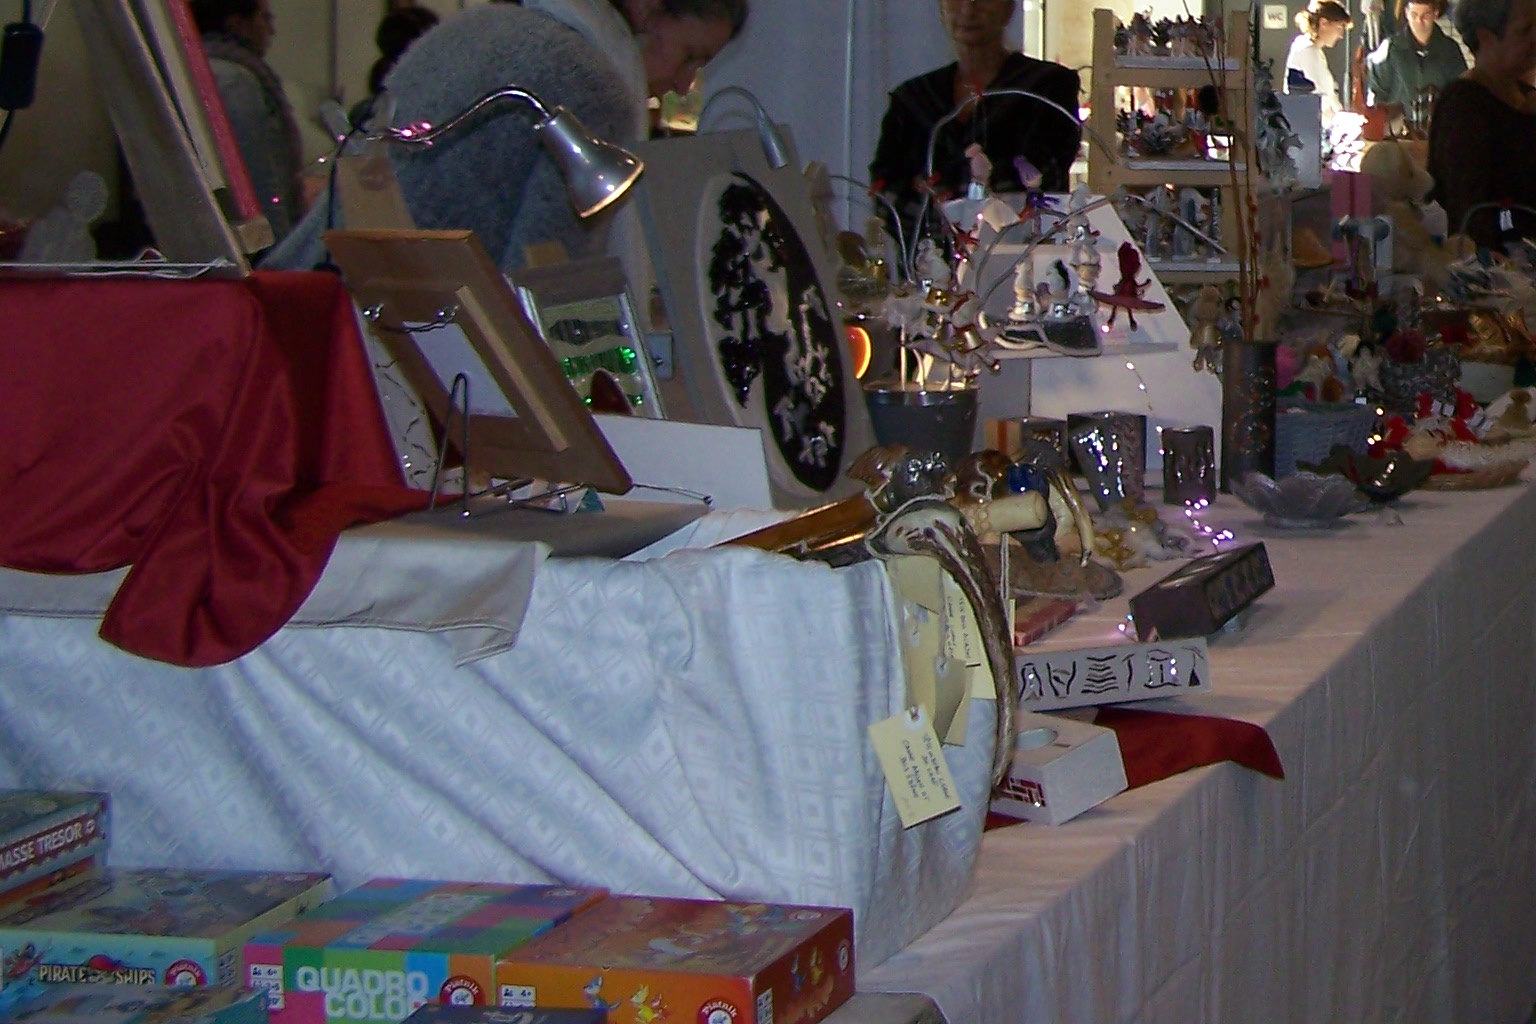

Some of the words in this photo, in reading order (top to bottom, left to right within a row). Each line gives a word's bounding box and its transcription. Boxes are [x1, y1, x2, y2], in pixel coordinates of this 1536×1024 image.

[36, 821, 84, 855] TRESOR
[38, 963, 88, 983] PIRATE
[113, 967, 157, 985] SHIPS
[296, 965, 429, 998] QUADRO
[445, 978, 480, 995] Piatnik
[701, 999, 739, 1019] Piatnik
